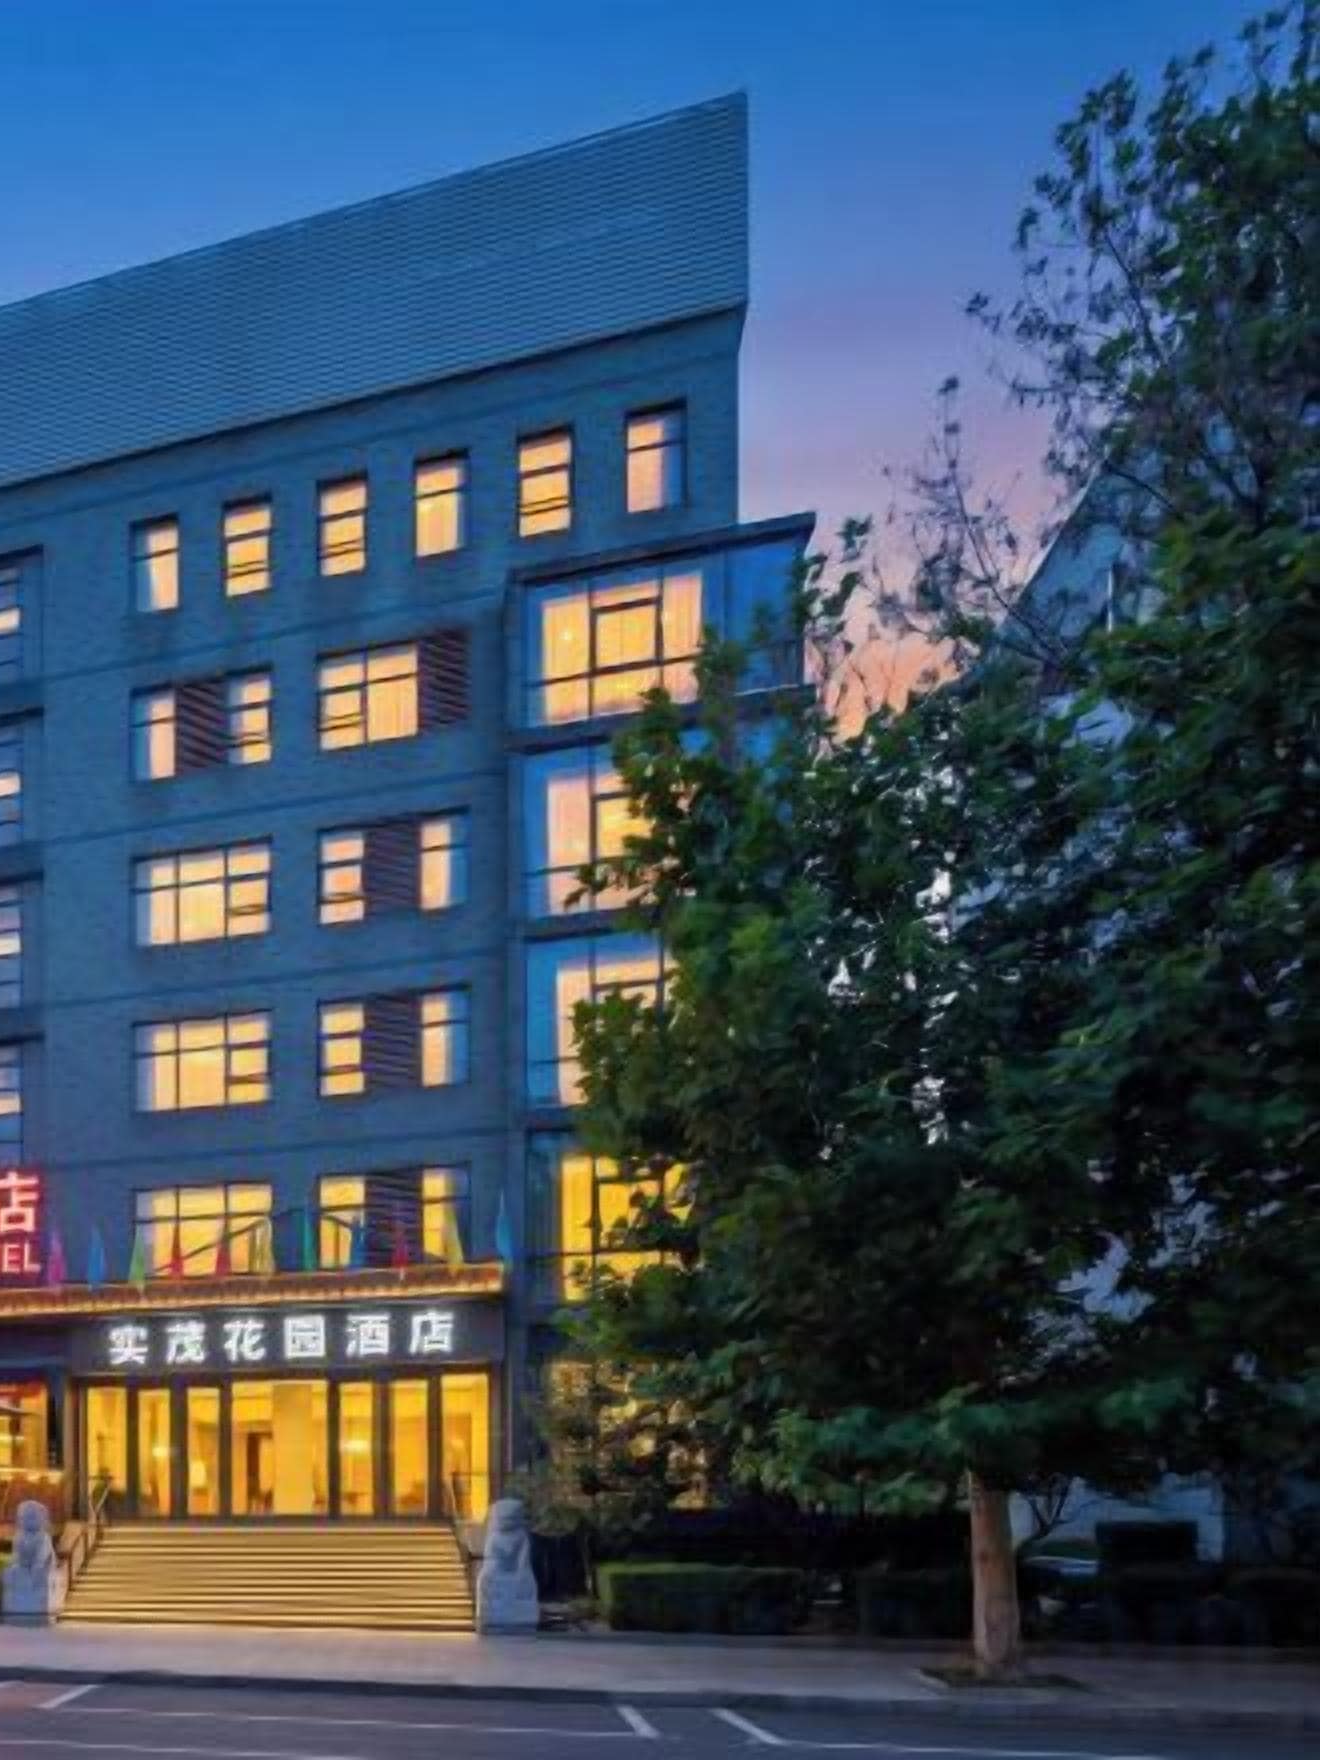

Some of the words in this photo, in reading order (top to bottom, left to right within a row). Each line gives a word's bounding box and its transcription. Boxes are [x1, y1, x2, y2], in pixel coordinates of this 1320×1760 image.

[108, 1311, 455, 1366] 实茂花园酒店
